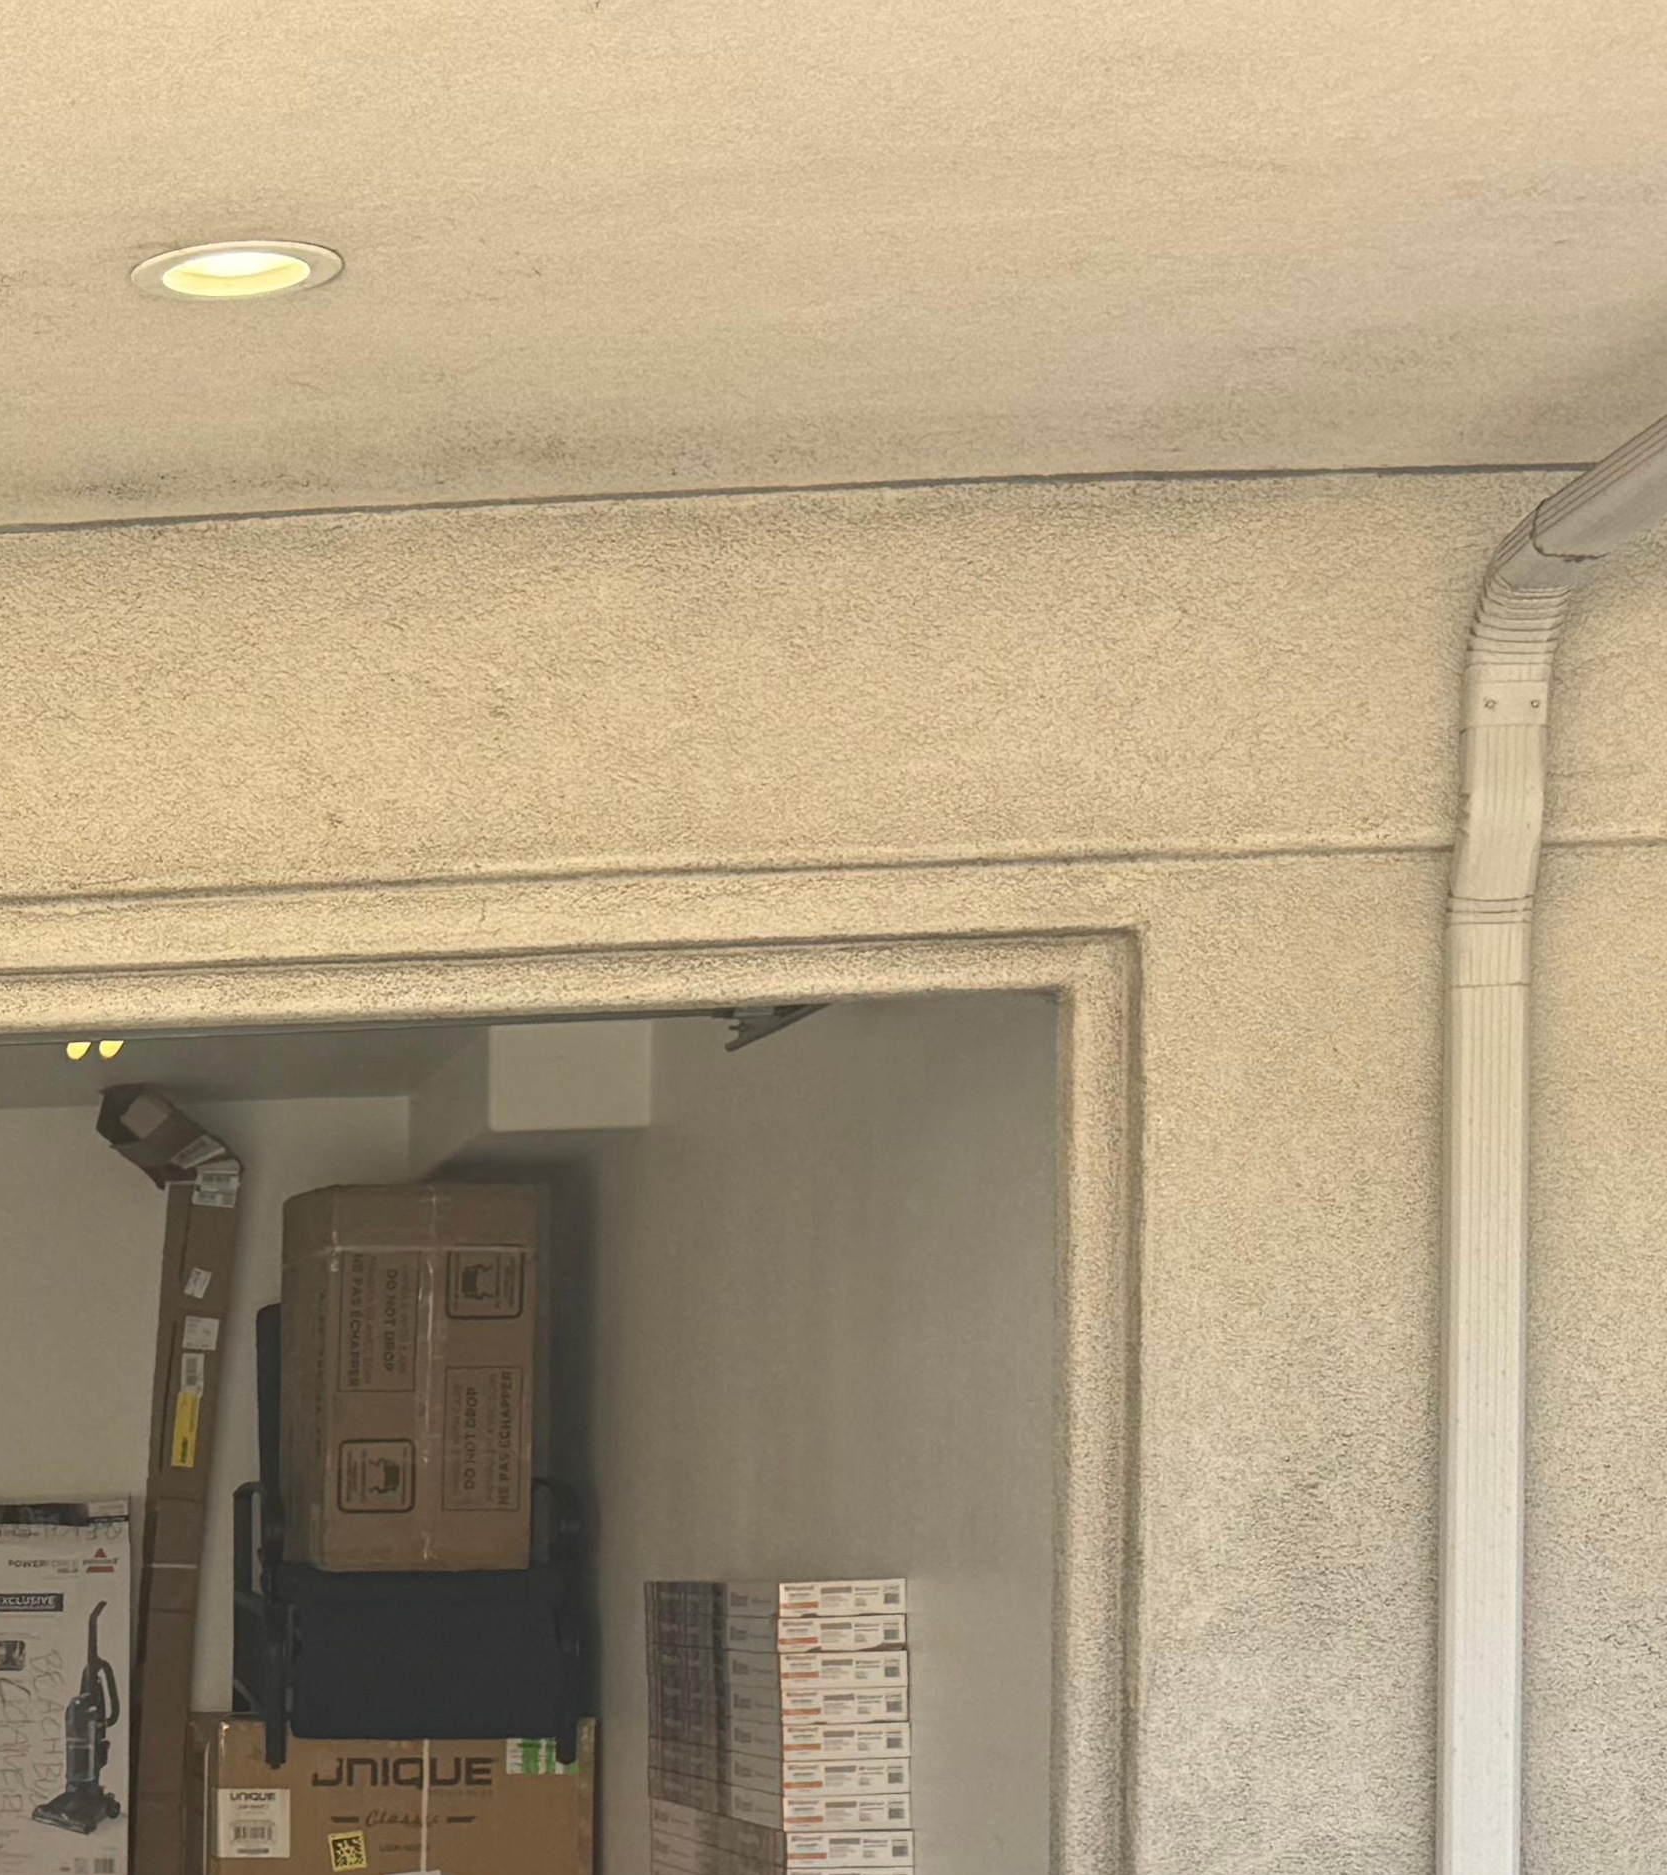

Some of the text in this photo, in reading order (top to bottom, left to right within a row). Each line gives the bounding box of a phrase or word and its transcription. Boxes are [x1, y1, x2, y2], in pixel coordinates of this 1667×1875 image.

[350, 1277, 364, 1307] PAS
[382, 1268, 399, 1372] DO NOT DROP
[464, 1387, 478, 1490] DO NOT DROP
[498, 1453, 510, 1482] PAS
[497, 1485, 510, 1505] NE
[311, 1755, 494, 1790] UNIQUE
[229, 1792, 276, 1801] UNIQUE
